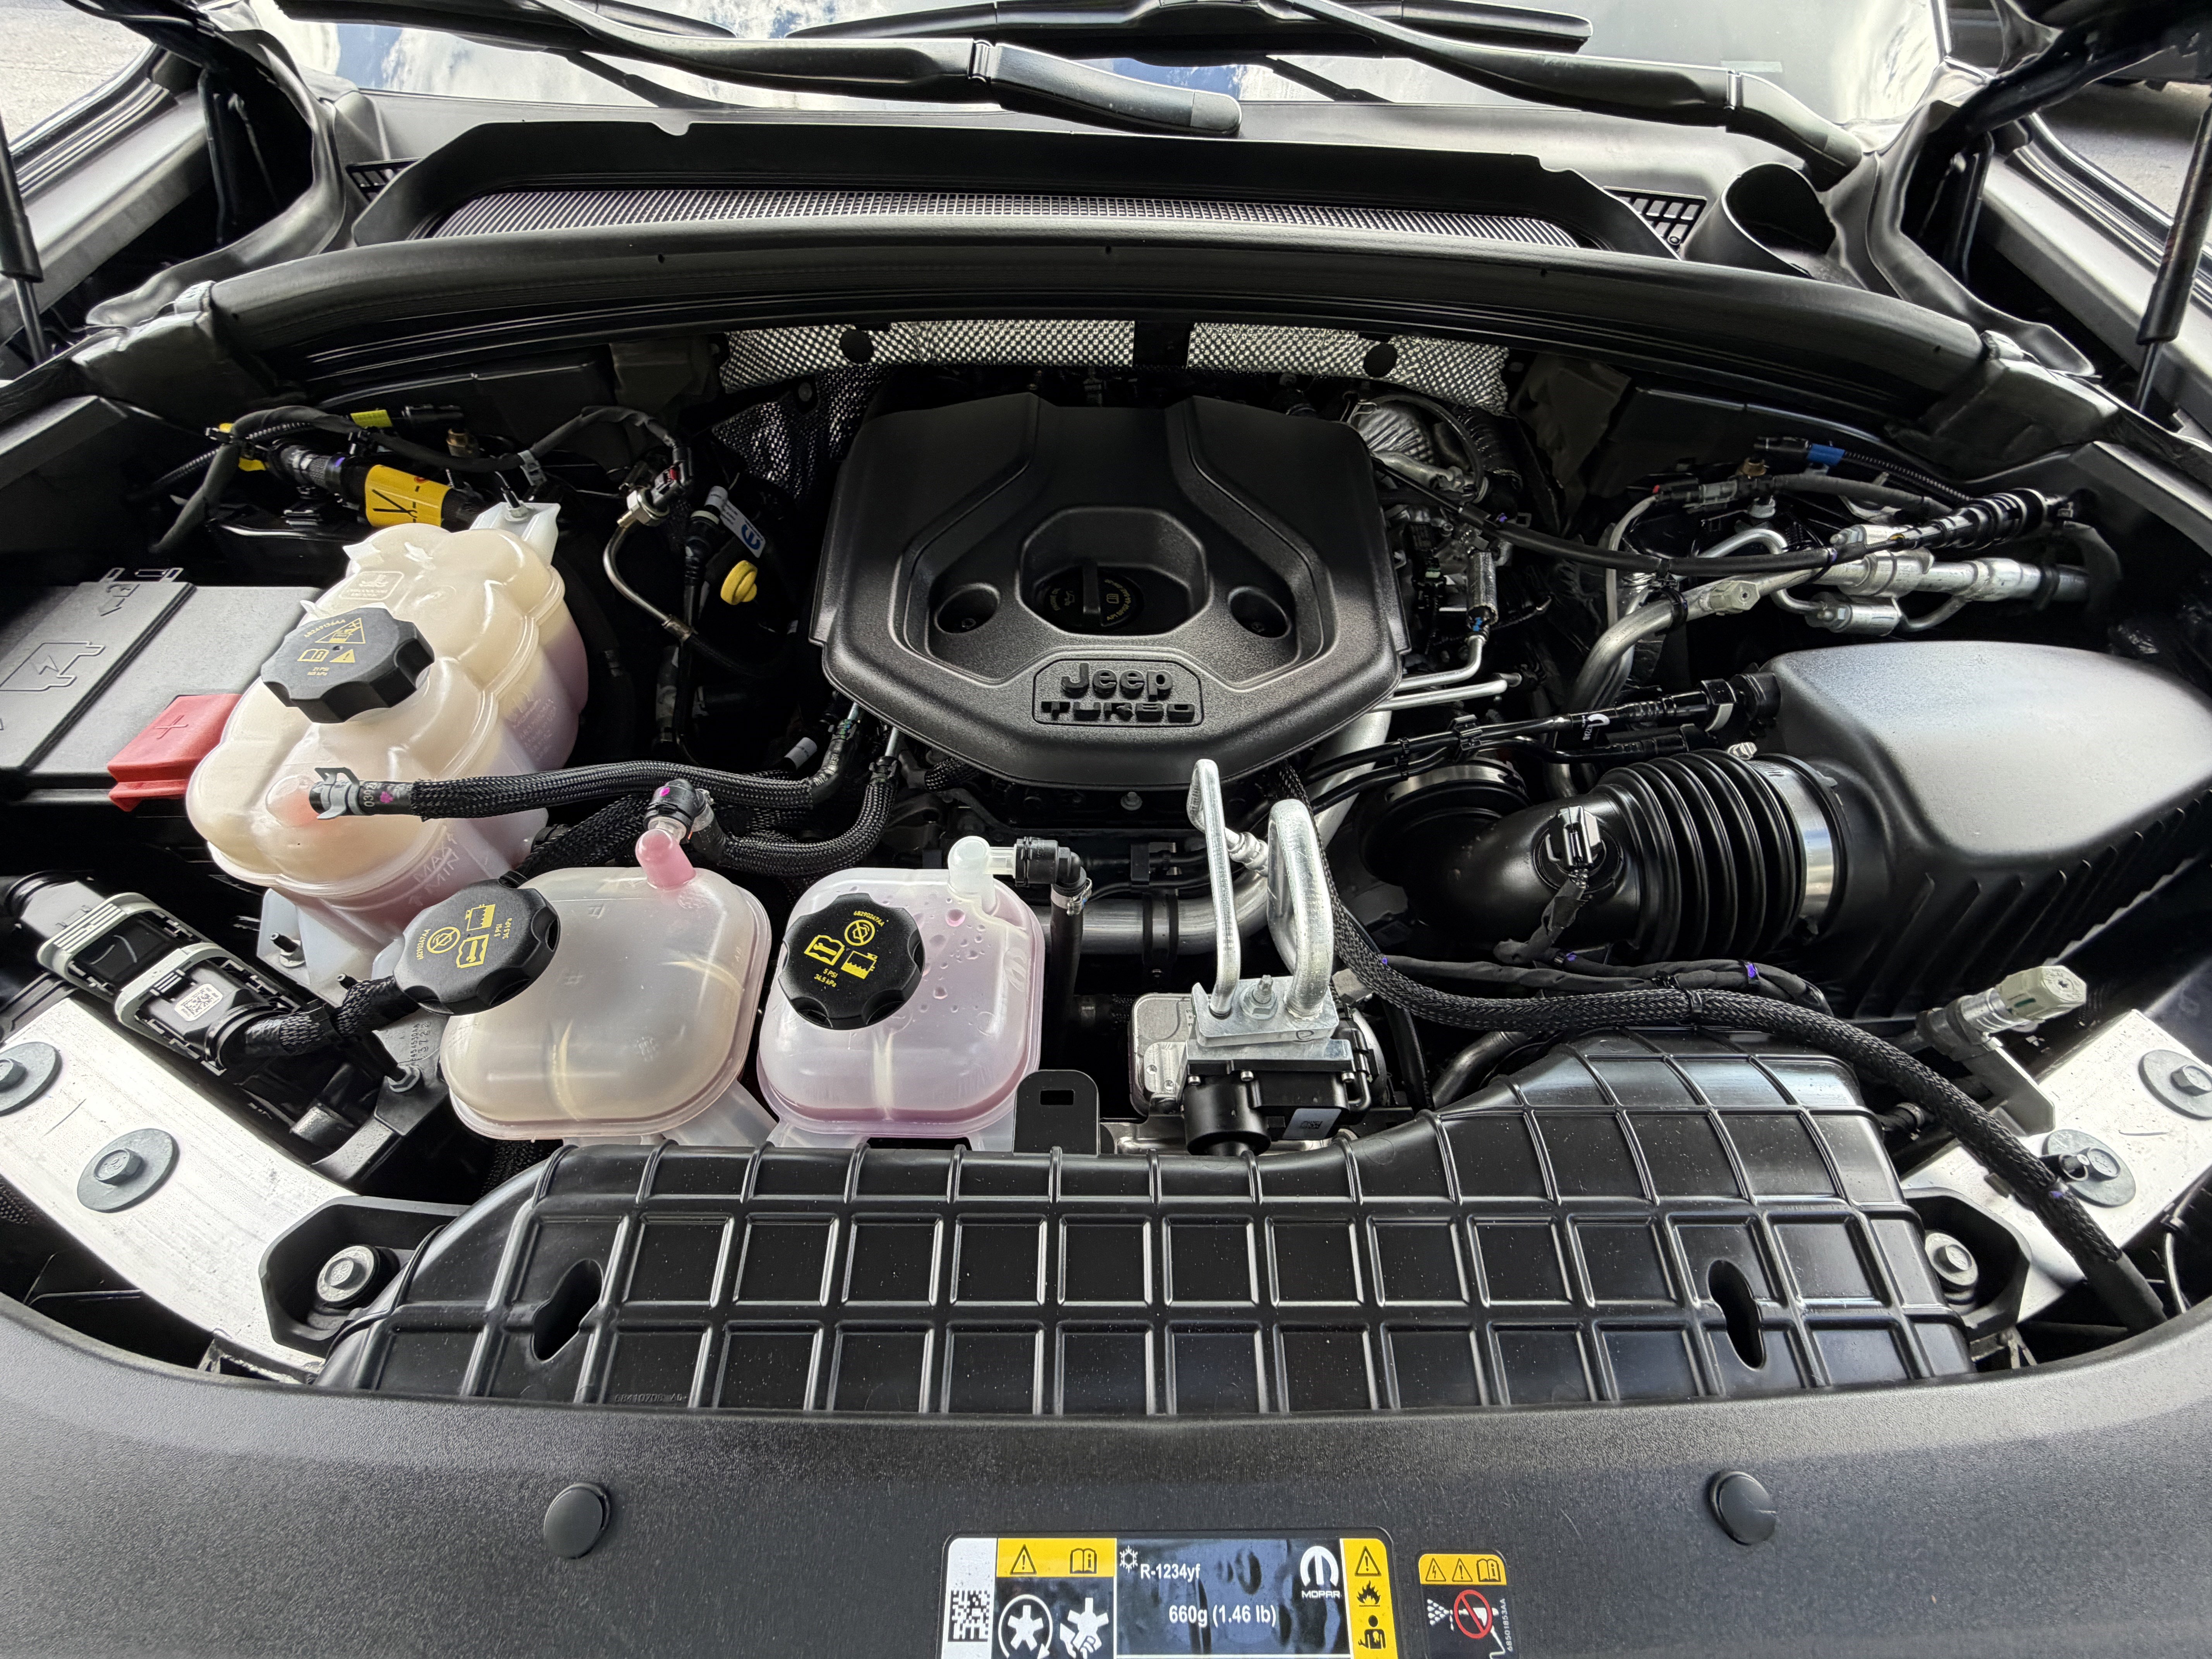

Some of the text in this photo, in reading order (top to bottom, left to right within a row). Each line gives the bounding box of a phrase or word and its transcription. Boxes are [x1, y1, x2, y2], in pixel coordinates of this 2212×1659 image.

[1061, 663, 1173, 701] Jeep
[828, 970, 838, 979] PSI
[825, 977, 837, 988] kPa
[1140, 1563, 1200, 1582] R-1234yf
[1302, 1590, 1341, 1599] MOPAR
[1169, 1604, 1277, 1628] 660g (1.46 lb)
